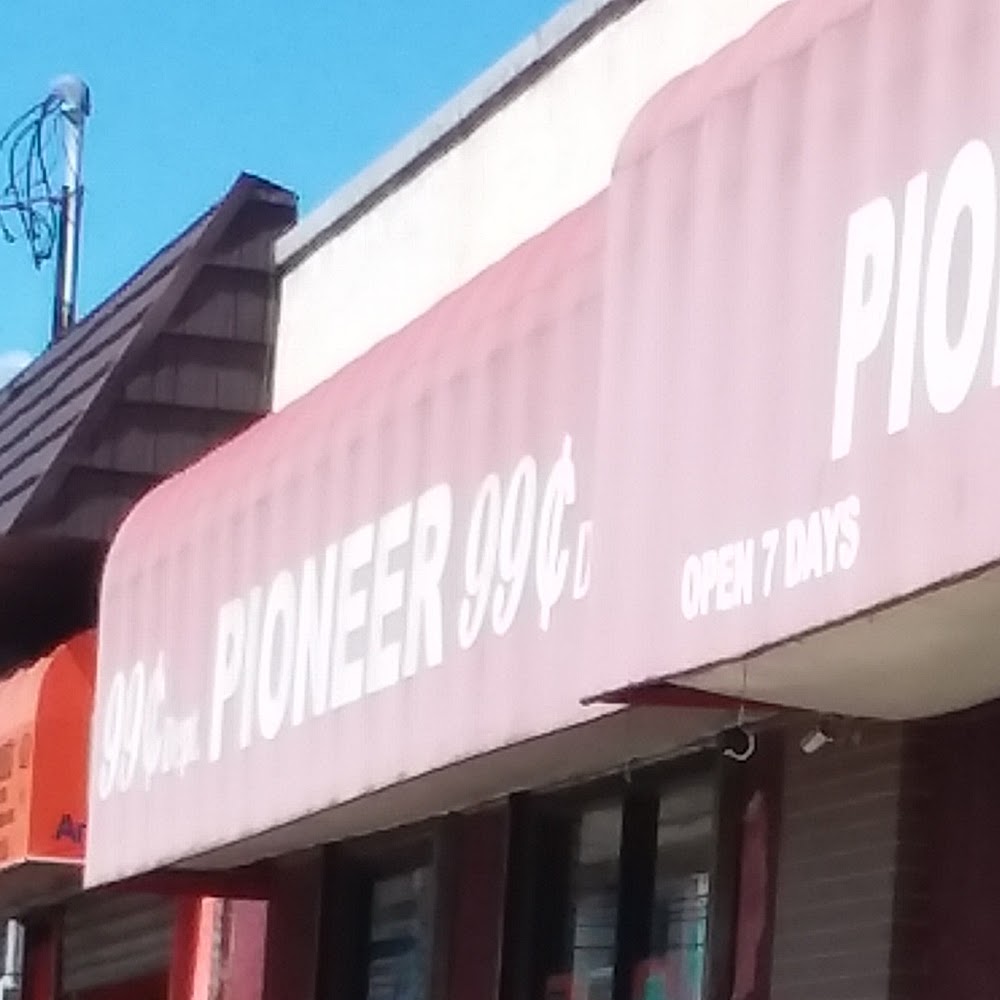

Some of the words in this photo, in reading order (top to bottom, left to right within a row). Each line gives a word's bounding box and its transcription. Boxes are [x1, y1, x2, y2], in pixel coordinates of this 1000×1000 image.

[207, 483, 454, 763] PIONEER
[457, 431, 577, 650] 99¢
[681, 537, 753, 619] OPEN
[760, 527, 779, 598] 7
[784, 494, 861, 588] DAYS
